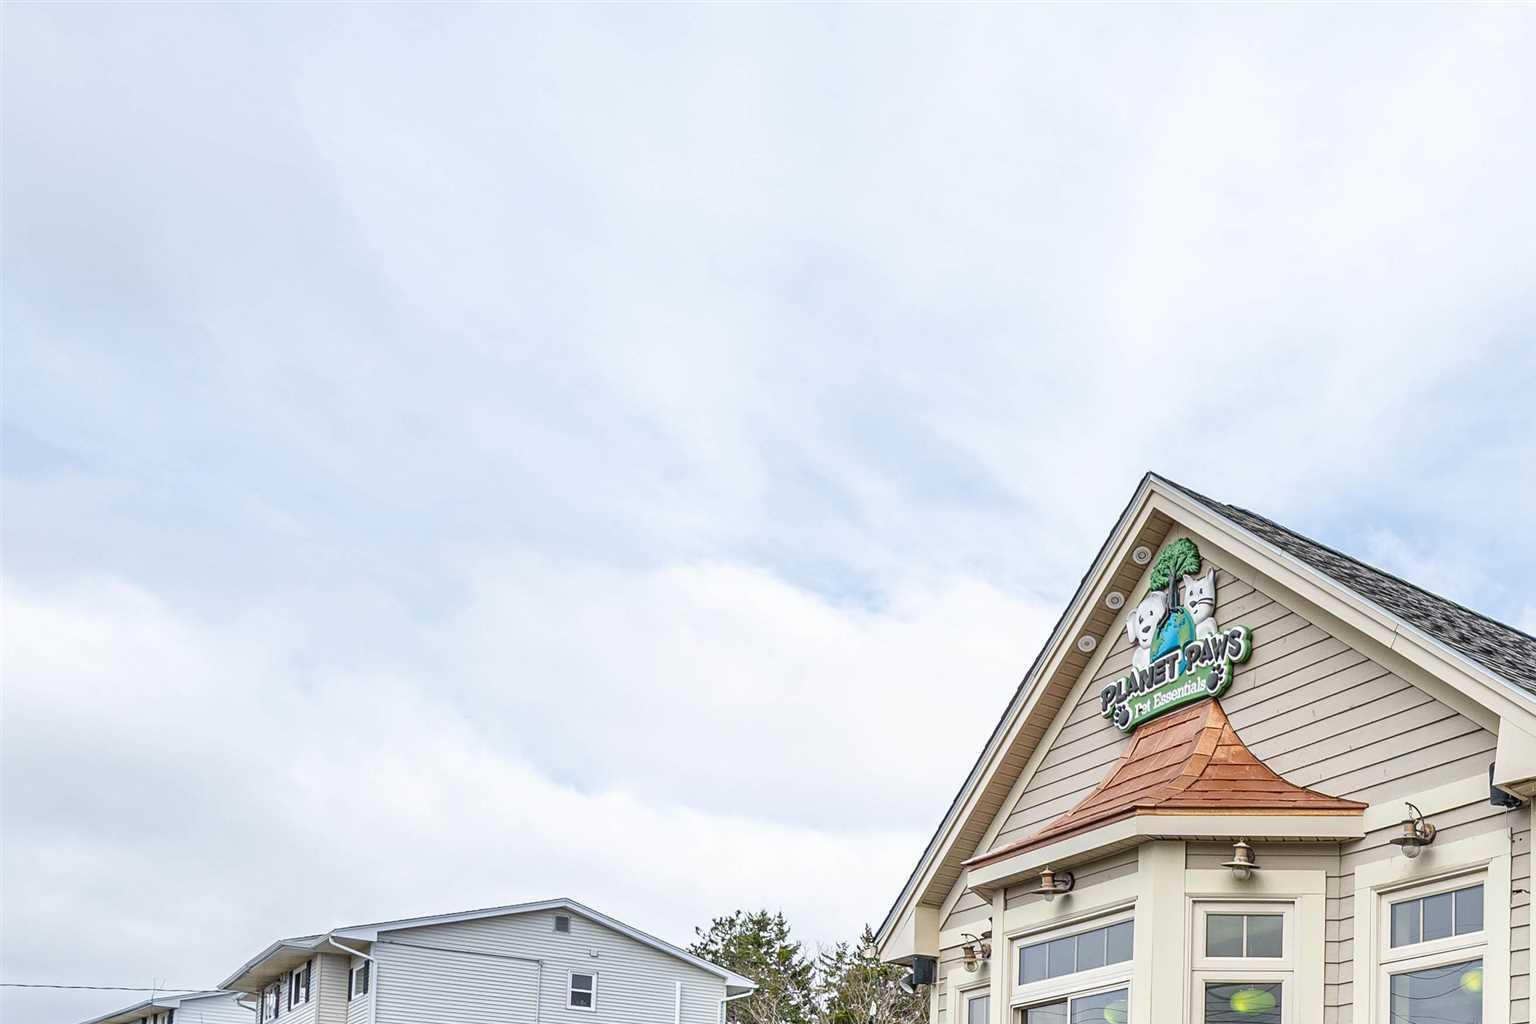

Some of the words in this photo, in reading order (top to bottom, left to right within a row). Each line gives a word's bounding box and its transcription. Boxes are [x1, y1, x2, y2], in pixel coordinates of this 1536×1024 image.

[1100, 652, 1180, 713] PLANET
[1184, 629, 1242, 672] PAWS
[1134, 698, 1151, 719] Pet
[1153, 677, 1207, 708] Essentials
